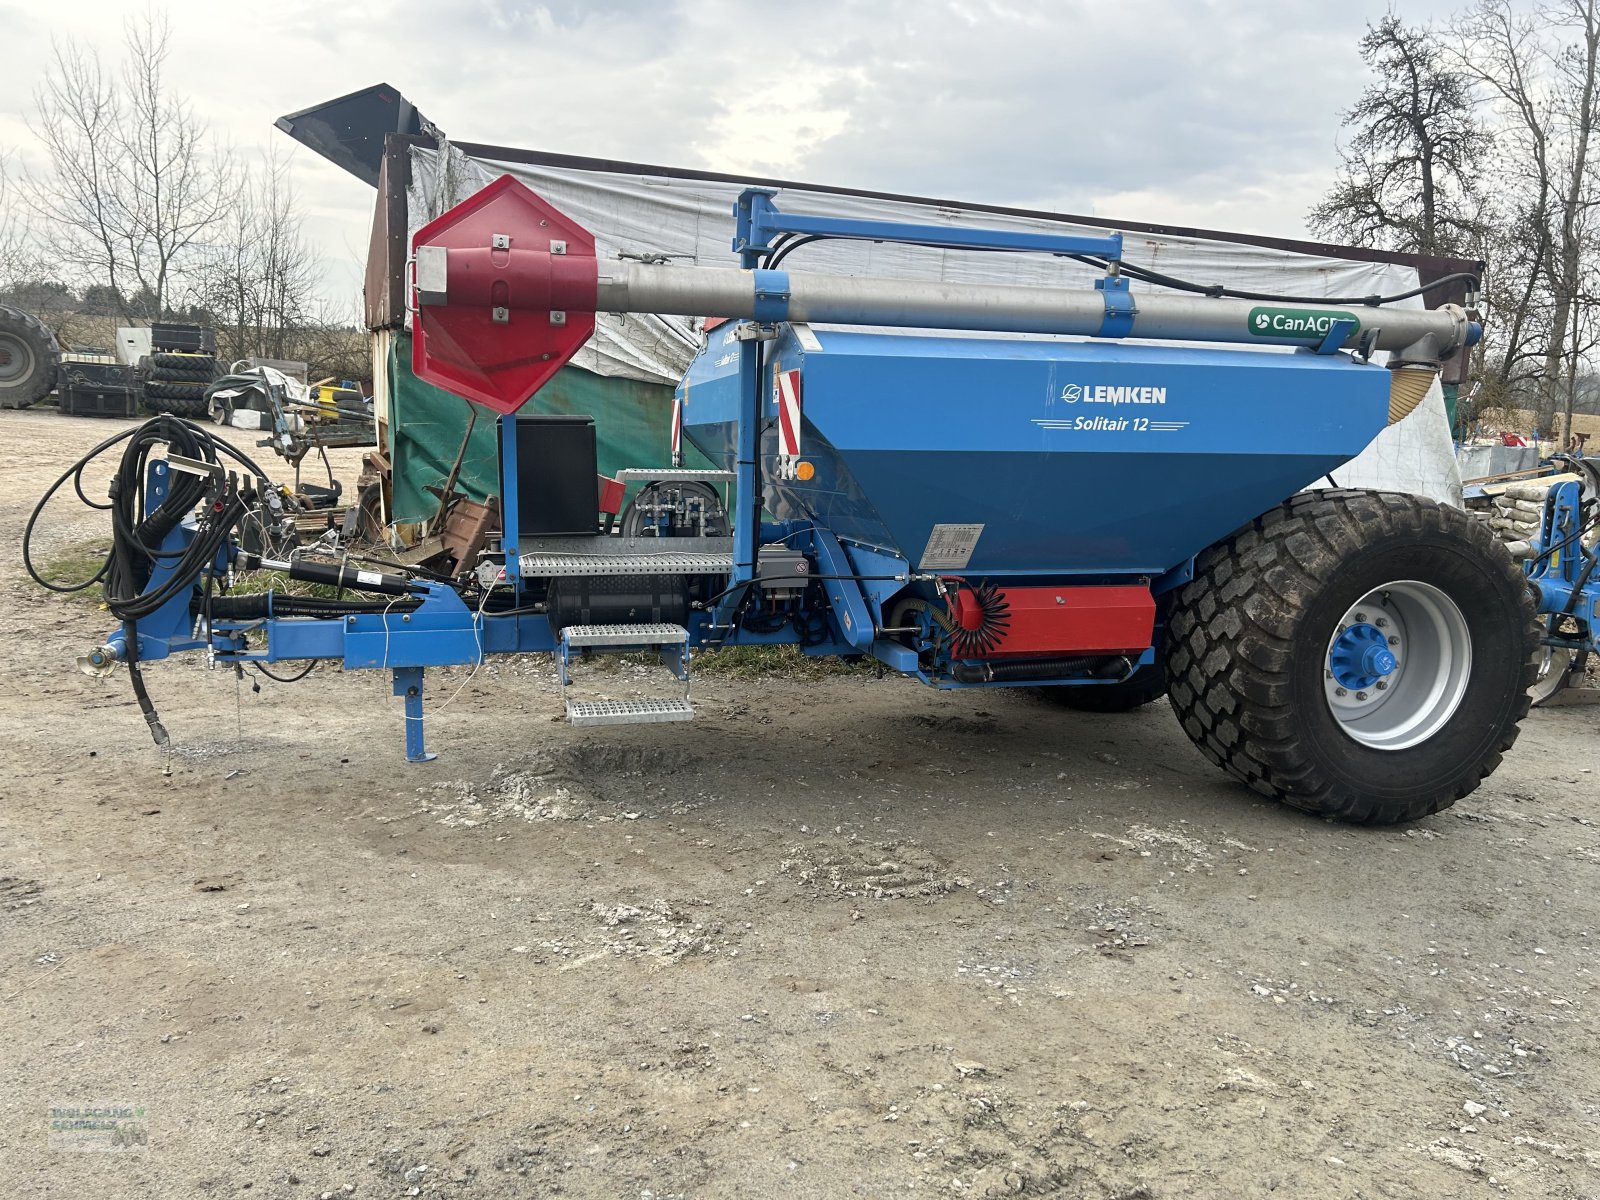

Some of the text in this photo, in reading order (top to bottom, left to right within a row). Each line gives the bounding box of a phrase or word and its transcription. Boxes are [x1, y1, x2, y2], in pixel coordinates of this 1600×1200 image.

[1083, 385, 1167, 407] LEMKEN
[1073, 416, 1149, 431] Solitair 12
